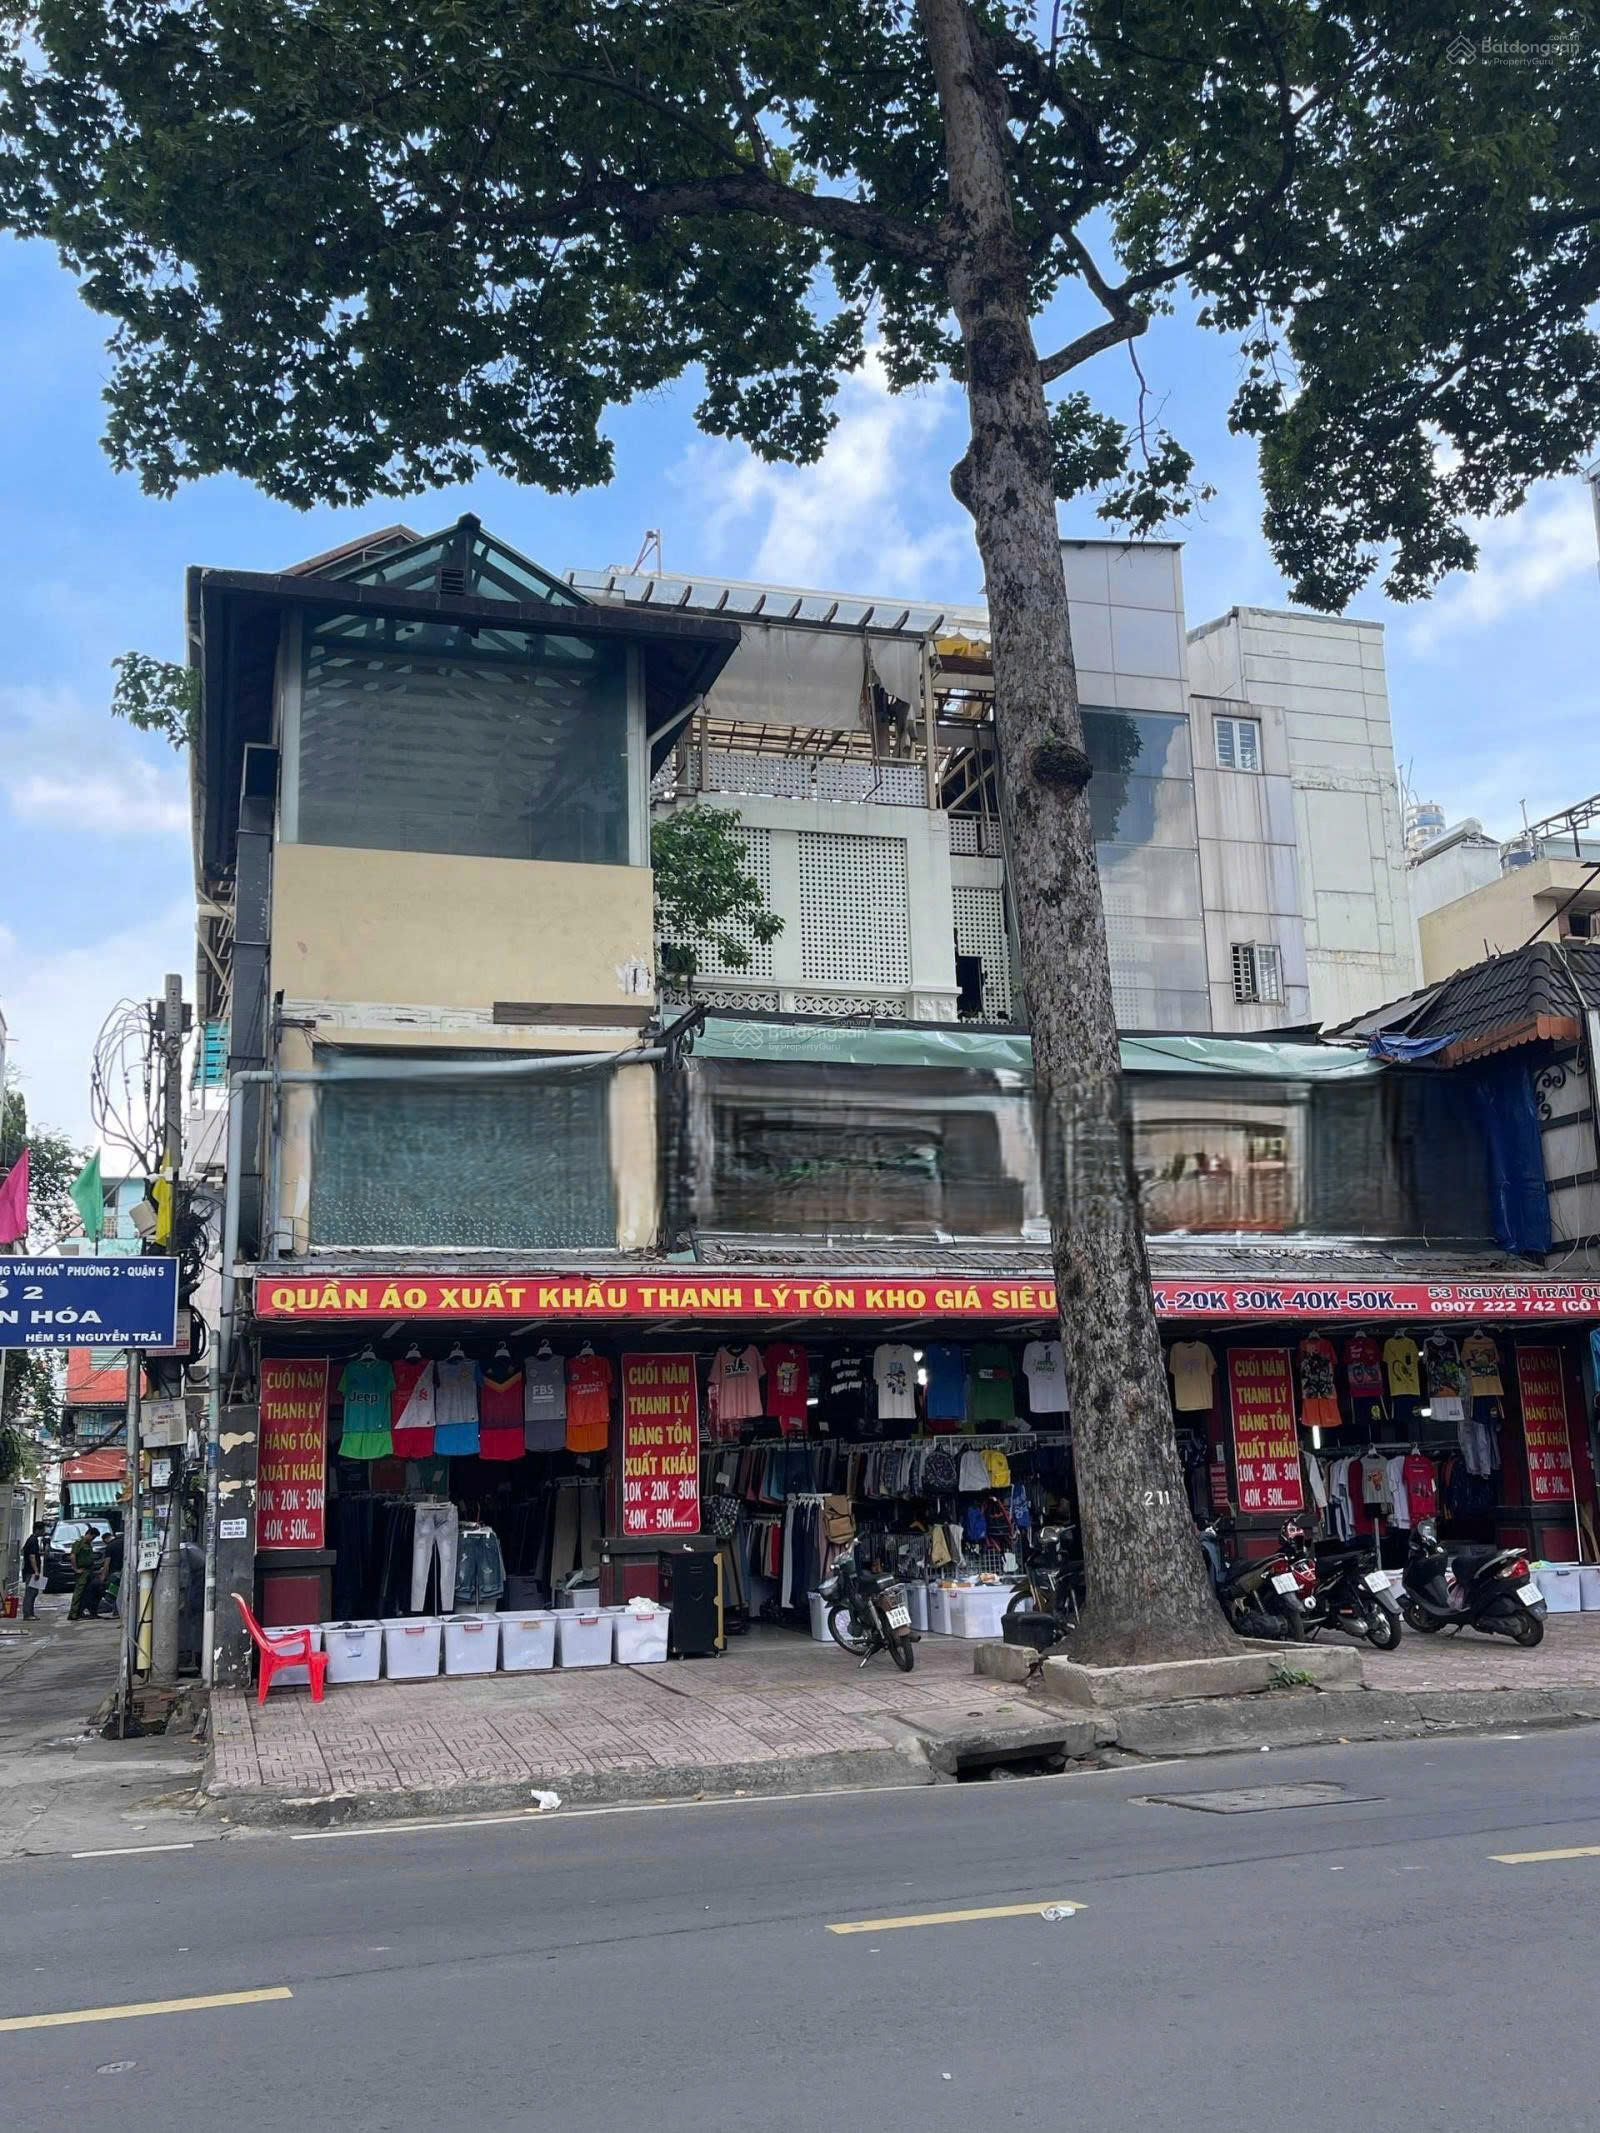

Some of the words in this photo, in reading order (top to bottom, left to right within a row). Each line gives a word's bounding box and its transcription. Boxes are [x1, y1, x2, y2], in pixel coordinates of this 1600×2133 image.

[13, 1262, 35, 1276] VĂN
[67, 1264, 111, 1277] PHƯỜNG
[112, 1266, 120, 1277] 2
[127, 1264, 156, 1279] QUẬN
[158, 1266, 165, 1277] 5
[22, 1286, 44, 1300] 2
[271, 1280, 368, 1313] QUẦN
[379, 1283, 428, 1309] ÁO
[438, 1281, 526, 1309] XUẤT
[637, 1287, 742, 1308] THANH
[865, 1289, 926, 1309] KHO
[935, 1285, 982, 1309] GIÁ
[992, 1286, 1057, 1309] SIÊU
[1428, 1287, 1452, 1299] 53
[31, 1306, 102, 1324] HÓA
[1430, 1301, 1475, 1312] 0907
[1482, 1301, 1517, 1312] 222
[1521, 1301, 1557, 1312] 742
[57, 1333, 71, 1343] 51
[628, 1360, 659, 1385] CUỐI
[661, 1363, 690, 1384] NĂM
[628, 1396, 671, 1415] THANH
[674, 1391, 690, 1414] LÝ
[1236, 1386, 1272, 1404] THANH
[1274, 1382, 1288, 1404] LÝ
[266, 1402, 306, 1419] THANH
[1239, 1409, 1269, 1432] HÀNG
[628, 1421, 664, 1446] HÀNG
[665, 1417, 692, 1446] TỒN
[1237, 1435, 1266, 1459] XUẤT
[624, 1449, 658, 1476] XUẤT
[661, 1446, 697, 1475] KHẨU
[1238, 1463, 1255, 1482] 10K
[1262, 1463, 1278, 1481] 20K
[281, 1488, 299, 1511] 20K
[624, 1481, 642, 1502] 10K
[650, 1480, 670, 1501] 20K
[678, 1479, 697, 1500] 30K
[1144, 1490, 1170, 1506] 211
[1244, 1488, 1261, 1507] 40K
[264, 1519, 283, 1541] 40K
